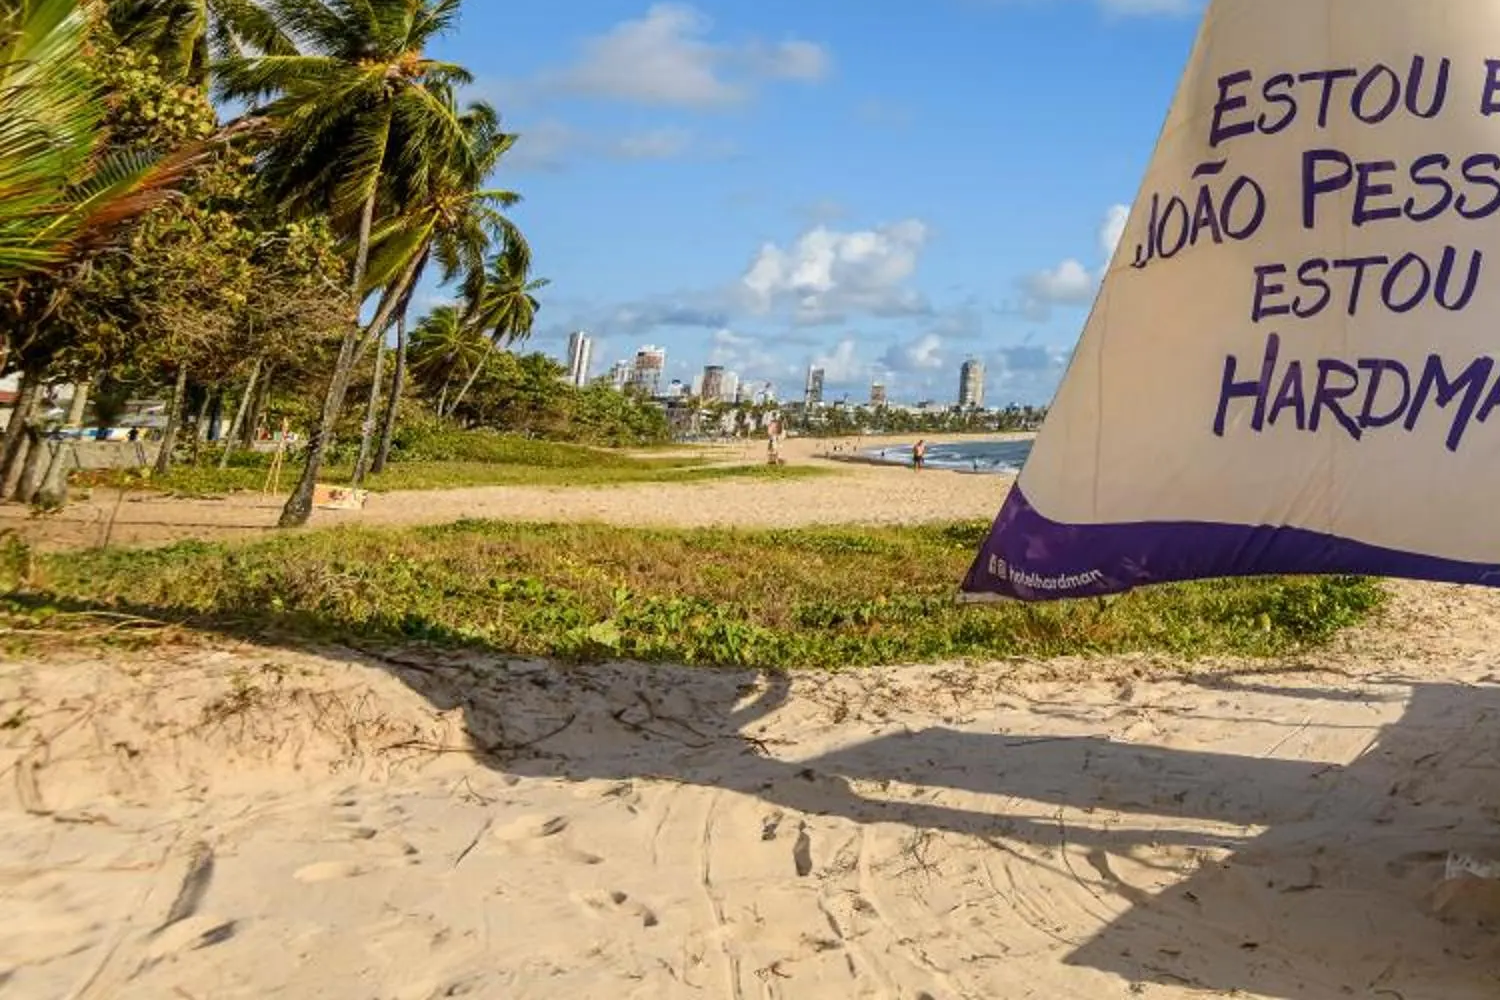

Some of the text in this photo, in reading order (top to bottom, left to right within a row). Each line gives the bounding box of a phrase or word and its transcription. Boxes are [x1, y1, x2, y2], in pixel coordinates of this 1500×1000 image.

[1209, 55, 1451, 147] ESTOU
[1129, 159, 1267, 269] JOÃO
[1252, 245, 1483, 323] ESTOU
